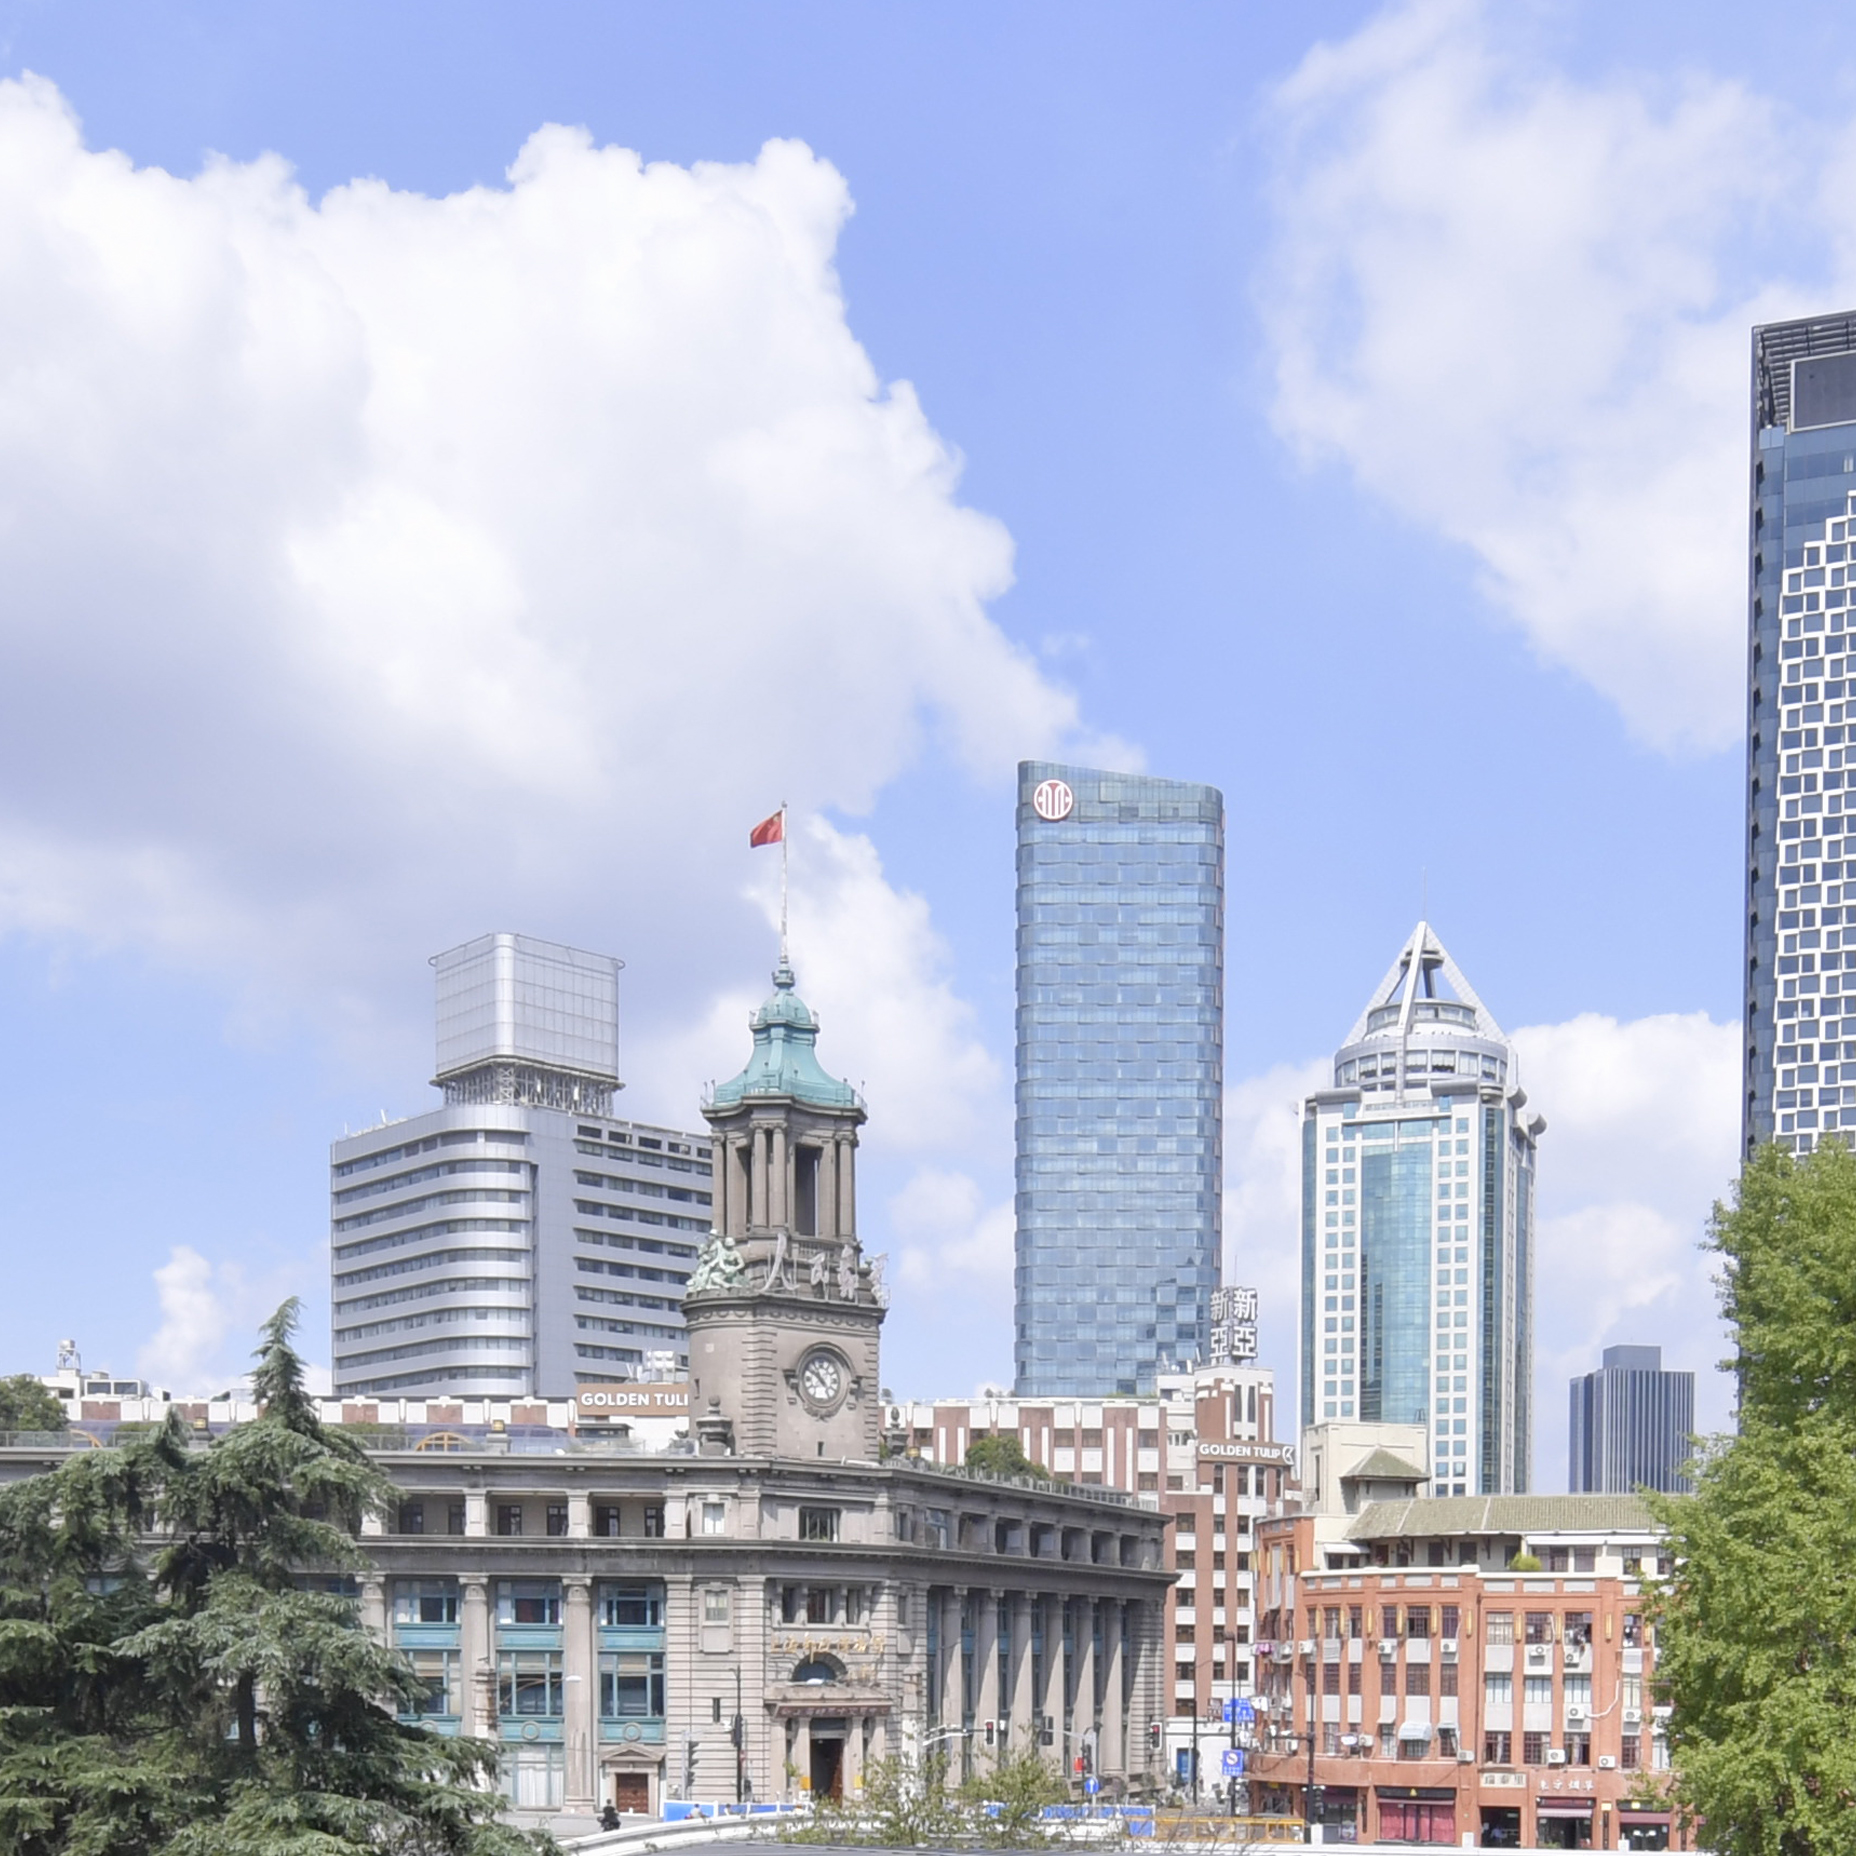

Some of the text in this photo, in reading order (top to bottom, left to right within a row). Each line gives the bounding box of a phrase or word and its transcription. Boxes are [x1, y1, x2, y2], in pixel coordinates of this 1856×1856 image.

[1232, 1287, 1258, 1359] 新亞
[581, 1392, 689, 1407] GOLDEN TULI
[1199, 1443, 1281, 1459] GOLDEN TULIP
